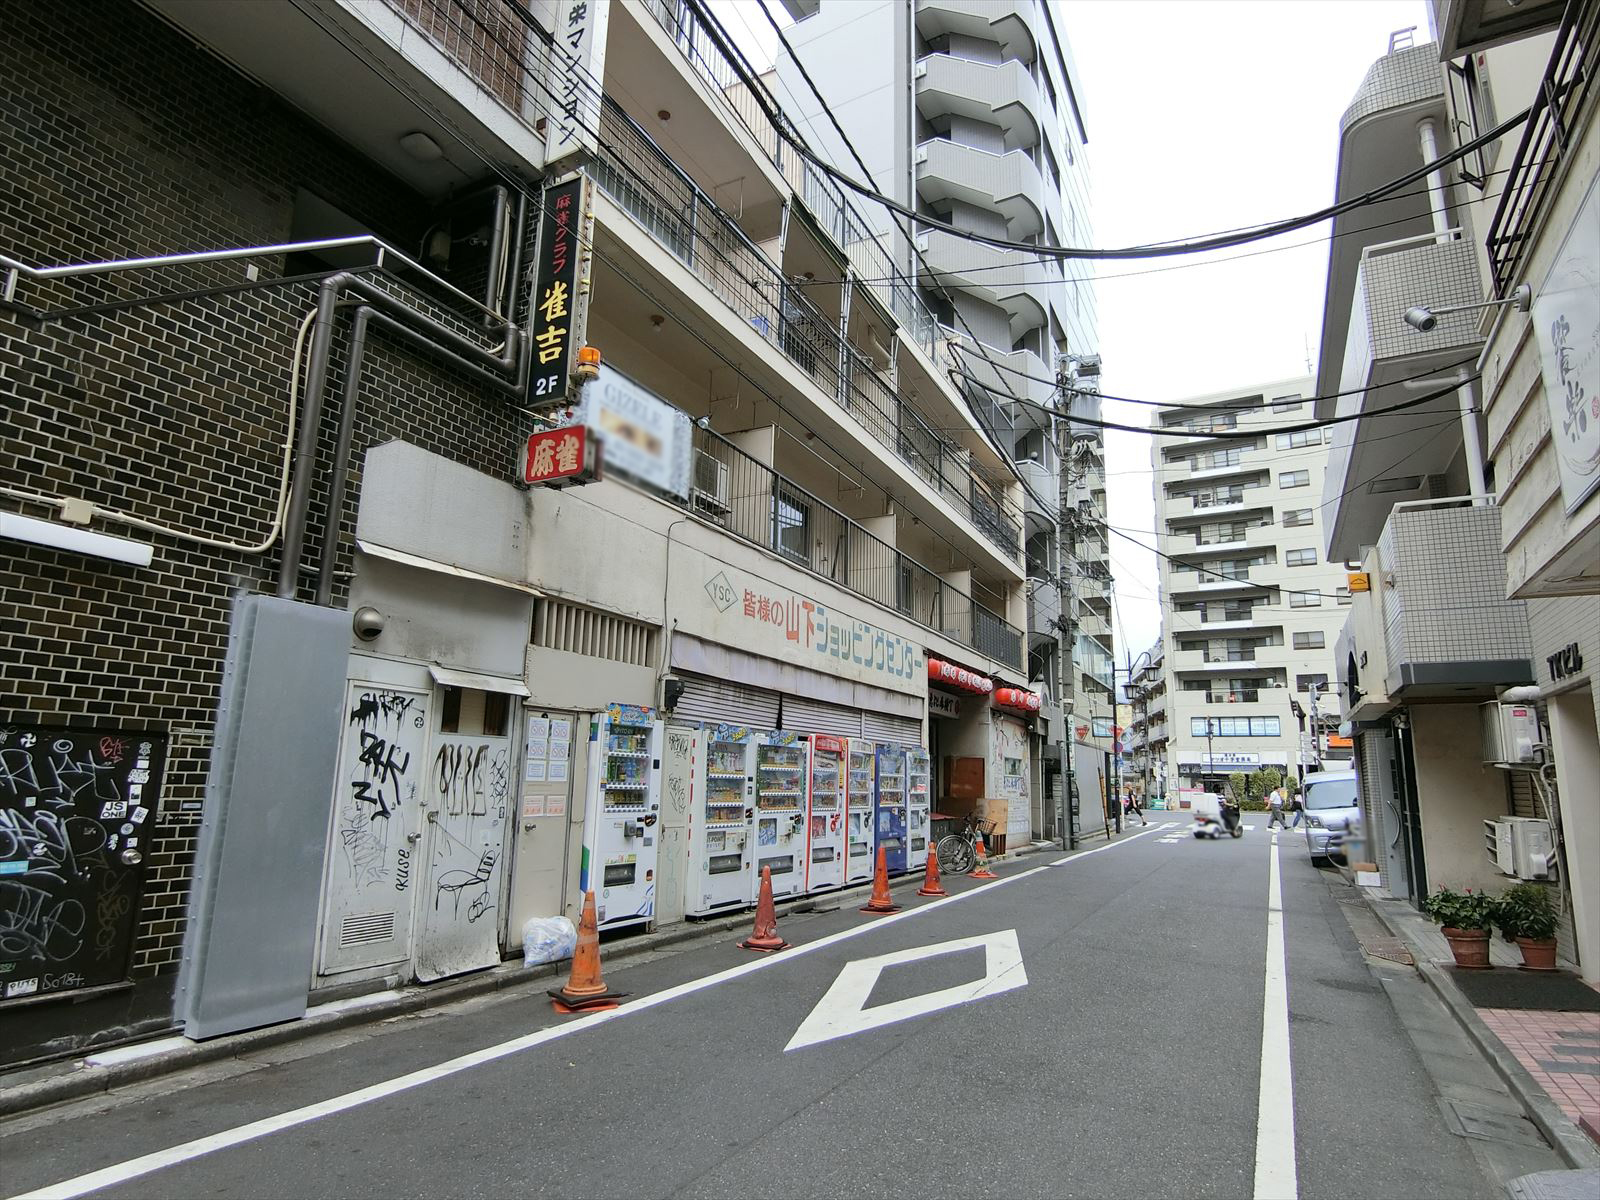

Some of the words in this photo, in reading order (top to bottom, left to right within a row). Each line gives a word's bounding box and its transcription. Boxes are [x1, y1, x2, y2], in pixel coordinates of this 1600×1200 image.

[559, 0, 587, 146] 栄マンション
[536, 281, 569, 365] 雀吉
[535, 374, 559, 397] 2F
[531, 434, 580, 477] 麻雀
[713, 583, 731, 603] YSC
[742, 588, 923, 680] 皆様の山下ショッピングセンター
[106, 802, 124, 811] JS
